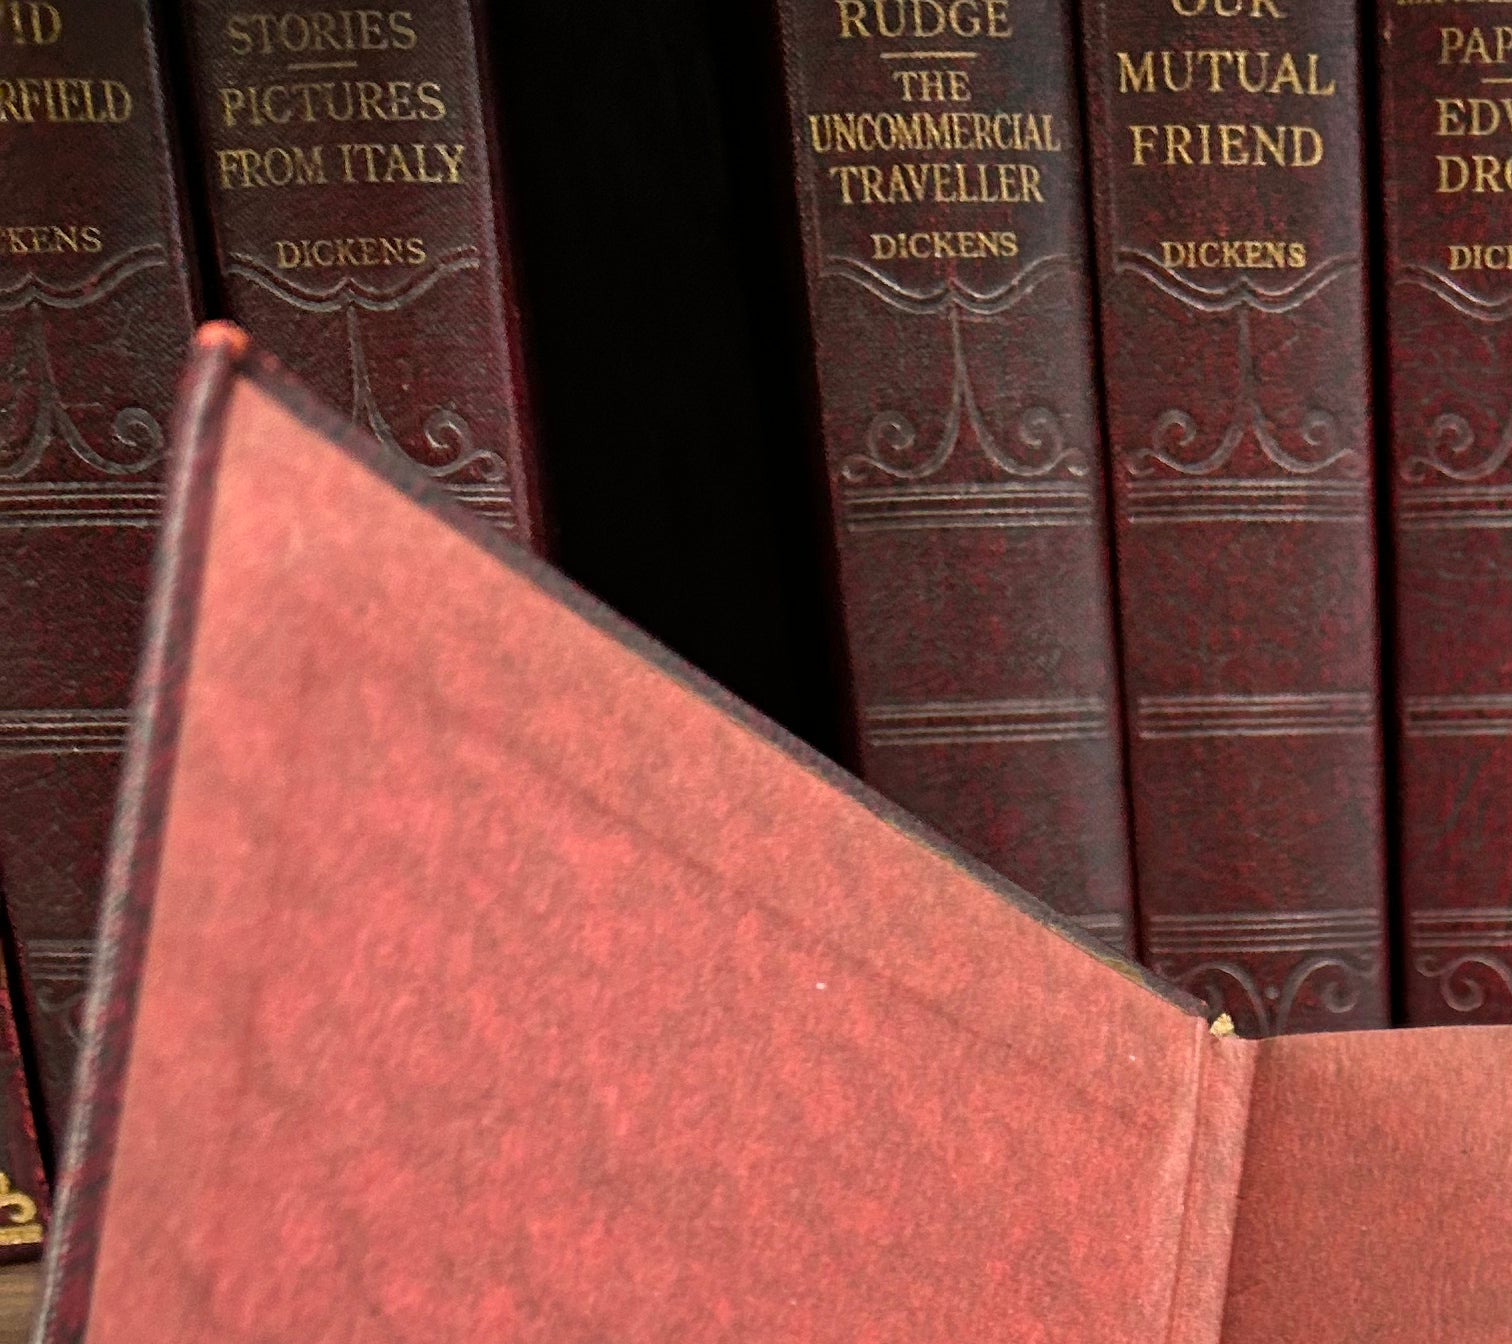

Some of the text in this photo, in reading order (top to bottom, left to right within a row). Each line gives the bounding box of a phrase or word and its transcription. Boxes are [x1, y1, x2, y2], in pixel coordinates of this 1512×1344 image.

[227, 11, 417, 55] STORIES
[839, 0, 1013, 38] RUDGE
[893, 71, 972, 102] THE
[1116, 51, 1337, 97] MUTUAL
[219, 81, 447, 127] PICTURES
[808, 112, 1061, 153] UNCOMMERCIAL
[1130, 125, 1324, 168] FRIEND
[216, 143, 465, 189] FROM ITALY
[830, 163, 1045, 205] TRAVELLER
[276, 237, 427, 269] DICKENS
[871, 231, 1018, 261] DICKENS
[1160, 241, 1307, 270] DICKENS
